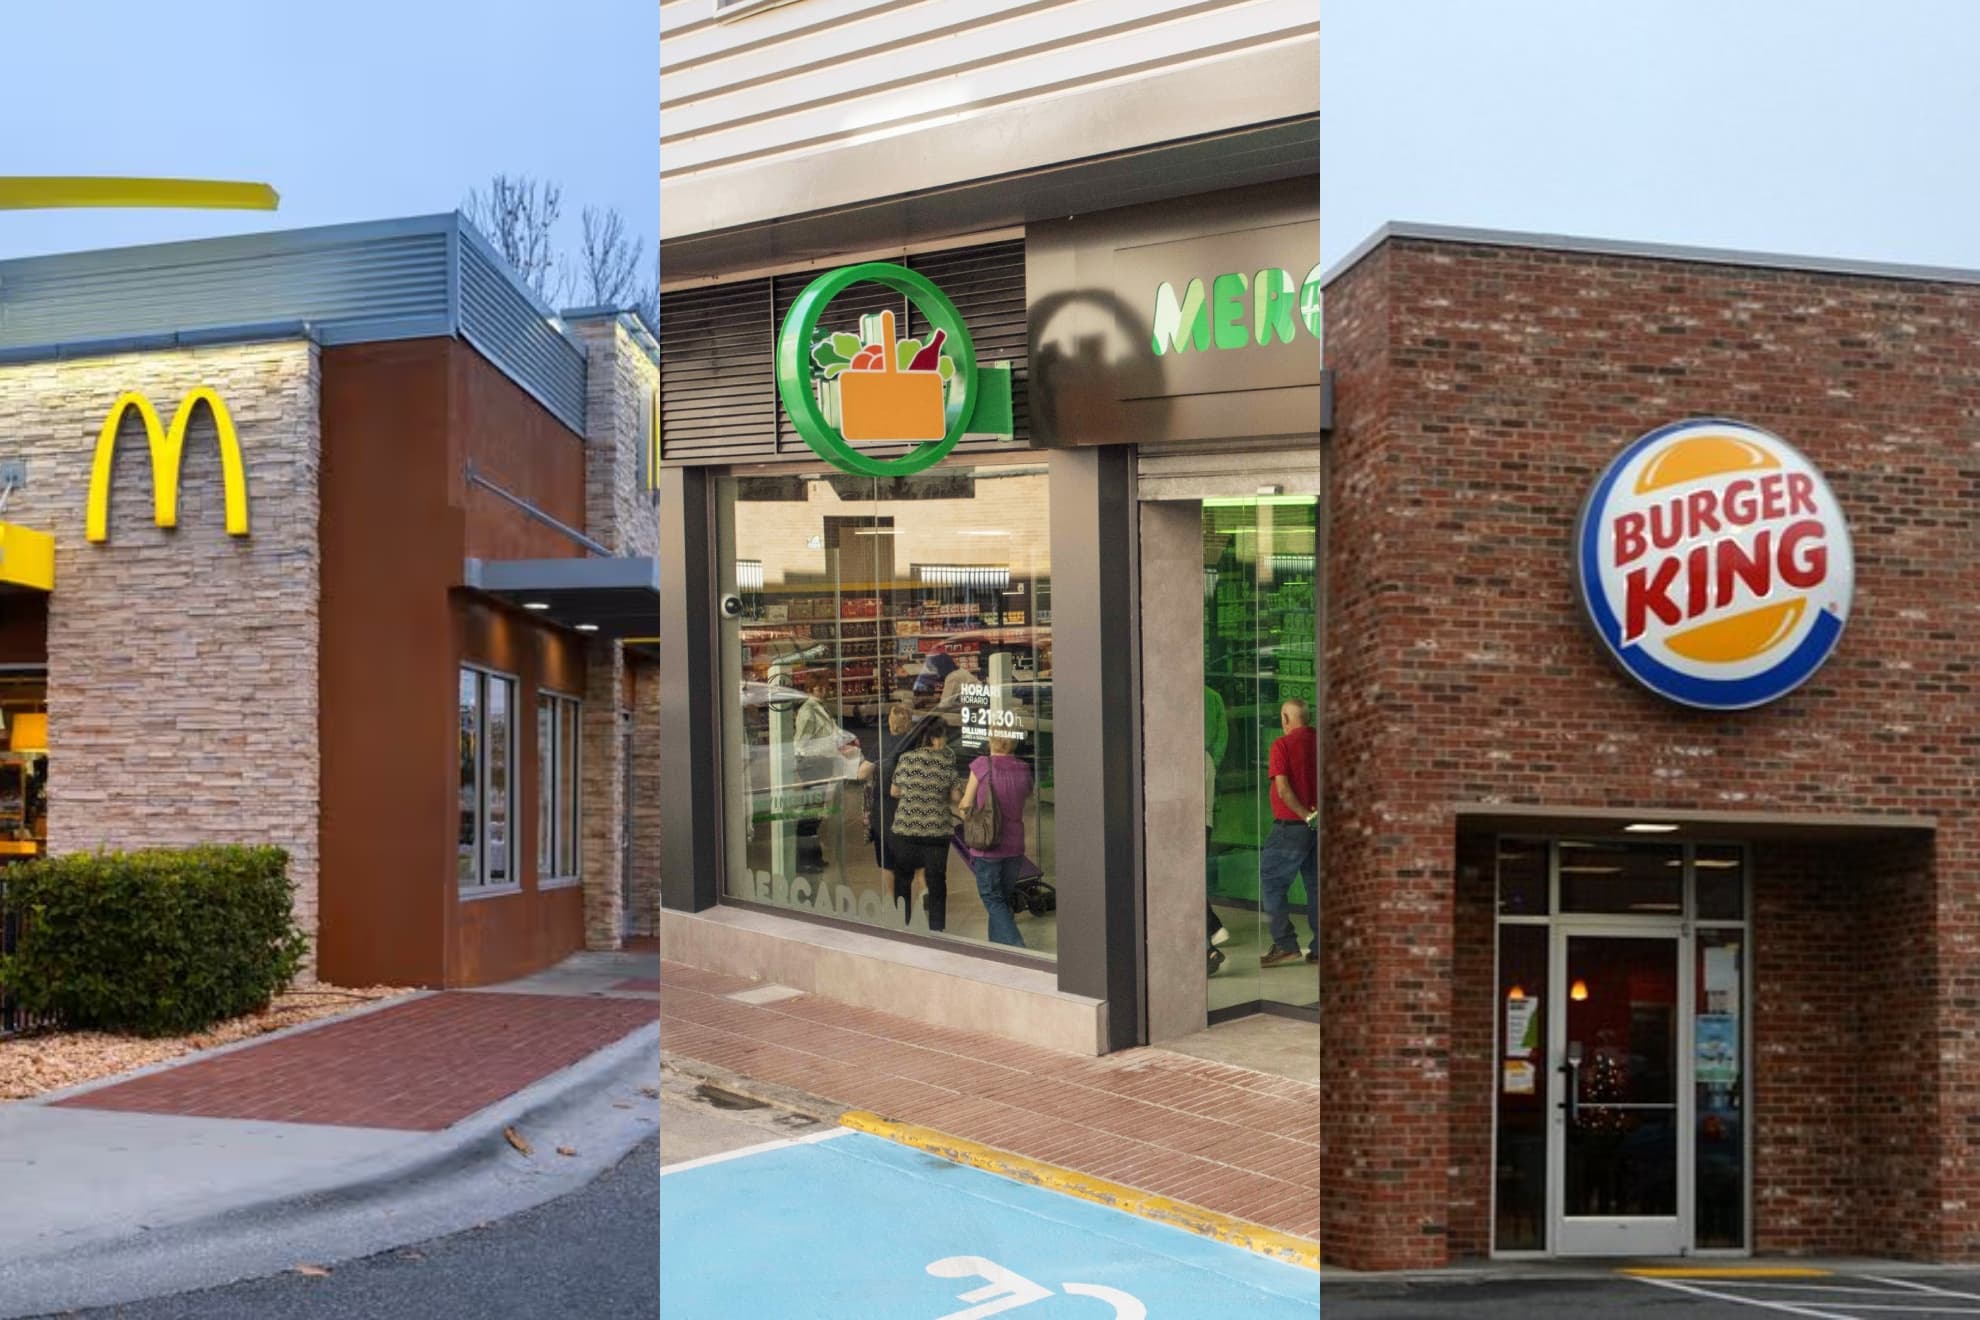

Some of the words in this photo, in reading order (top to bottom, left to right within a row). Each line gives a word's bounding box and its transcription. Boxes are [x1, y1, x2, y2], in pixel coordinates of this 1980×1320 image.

[1613, 472, 1818, 568] BURGER
[1625, 519, 1828, 643] KING
[961, 707, 970, 723] 9
[970, 712, 977, 723] a
